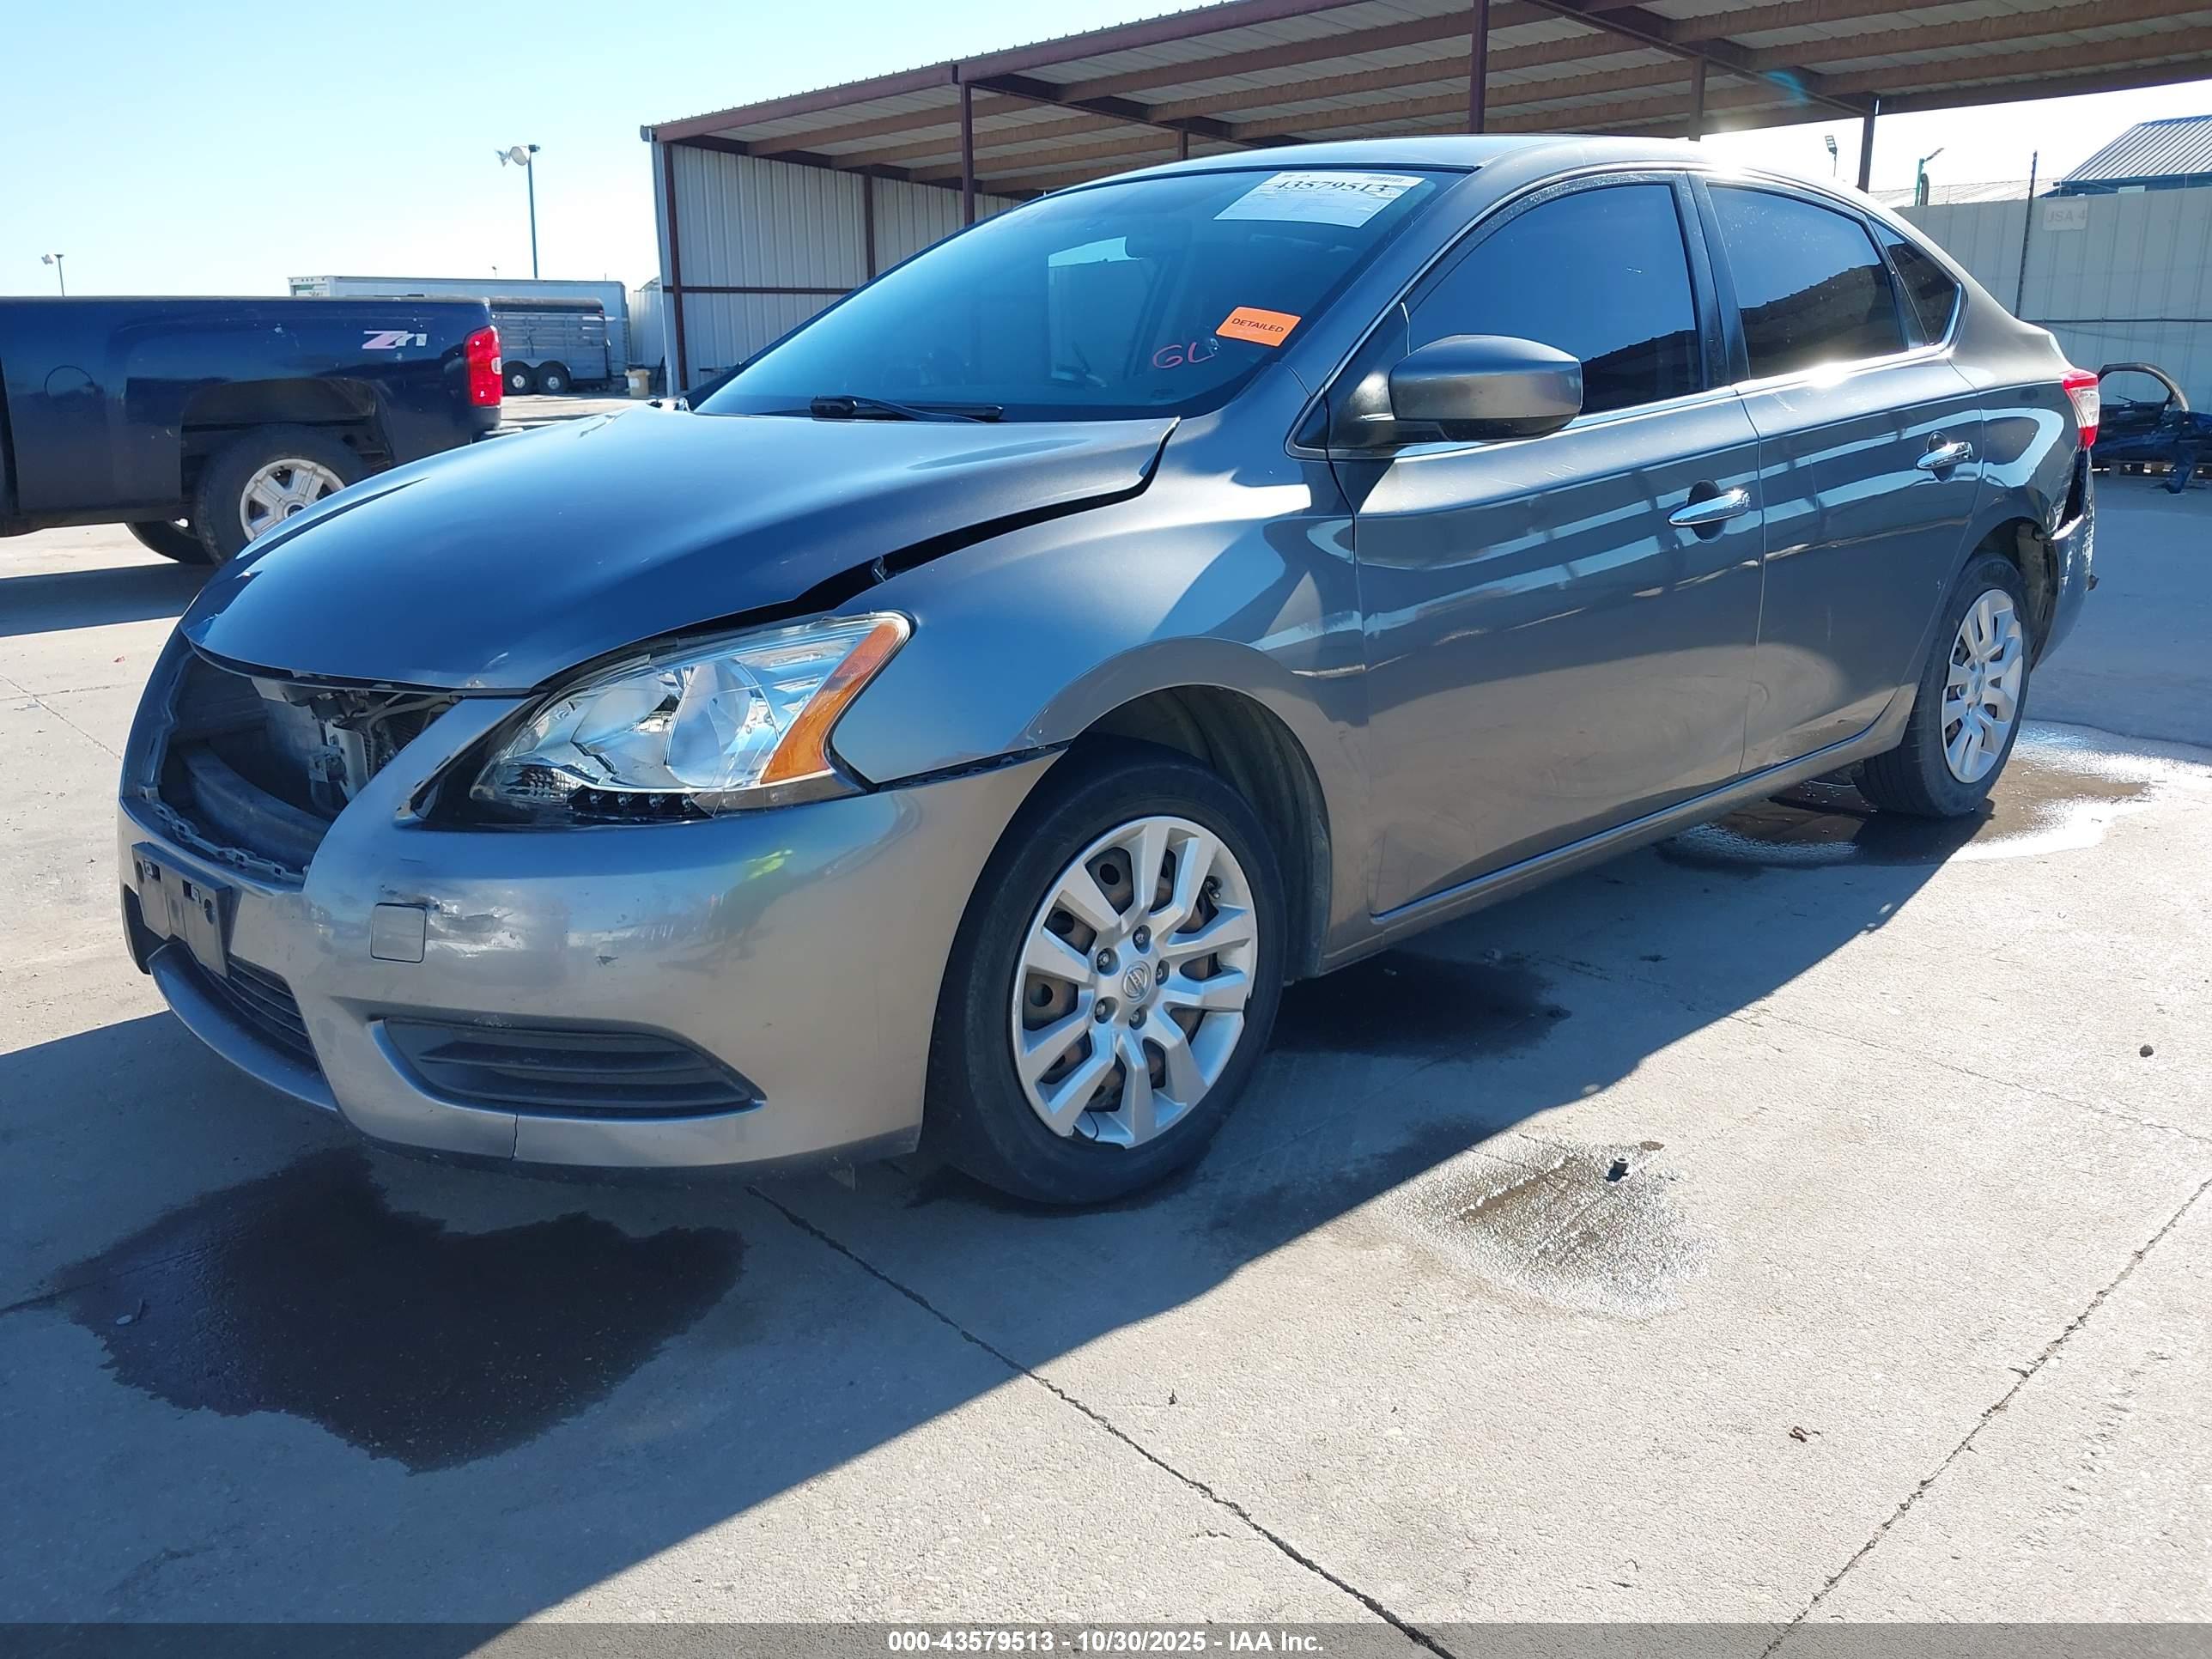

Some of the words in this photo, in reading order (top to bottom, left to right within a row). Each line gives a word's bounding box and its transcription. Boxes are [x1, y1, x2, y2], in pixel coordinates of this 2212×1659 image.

[1273, 179, 1389, 193] 43579513
[1231, 317, 1284, 332] DETAILED
[362, 331, 428, 349] Z71
